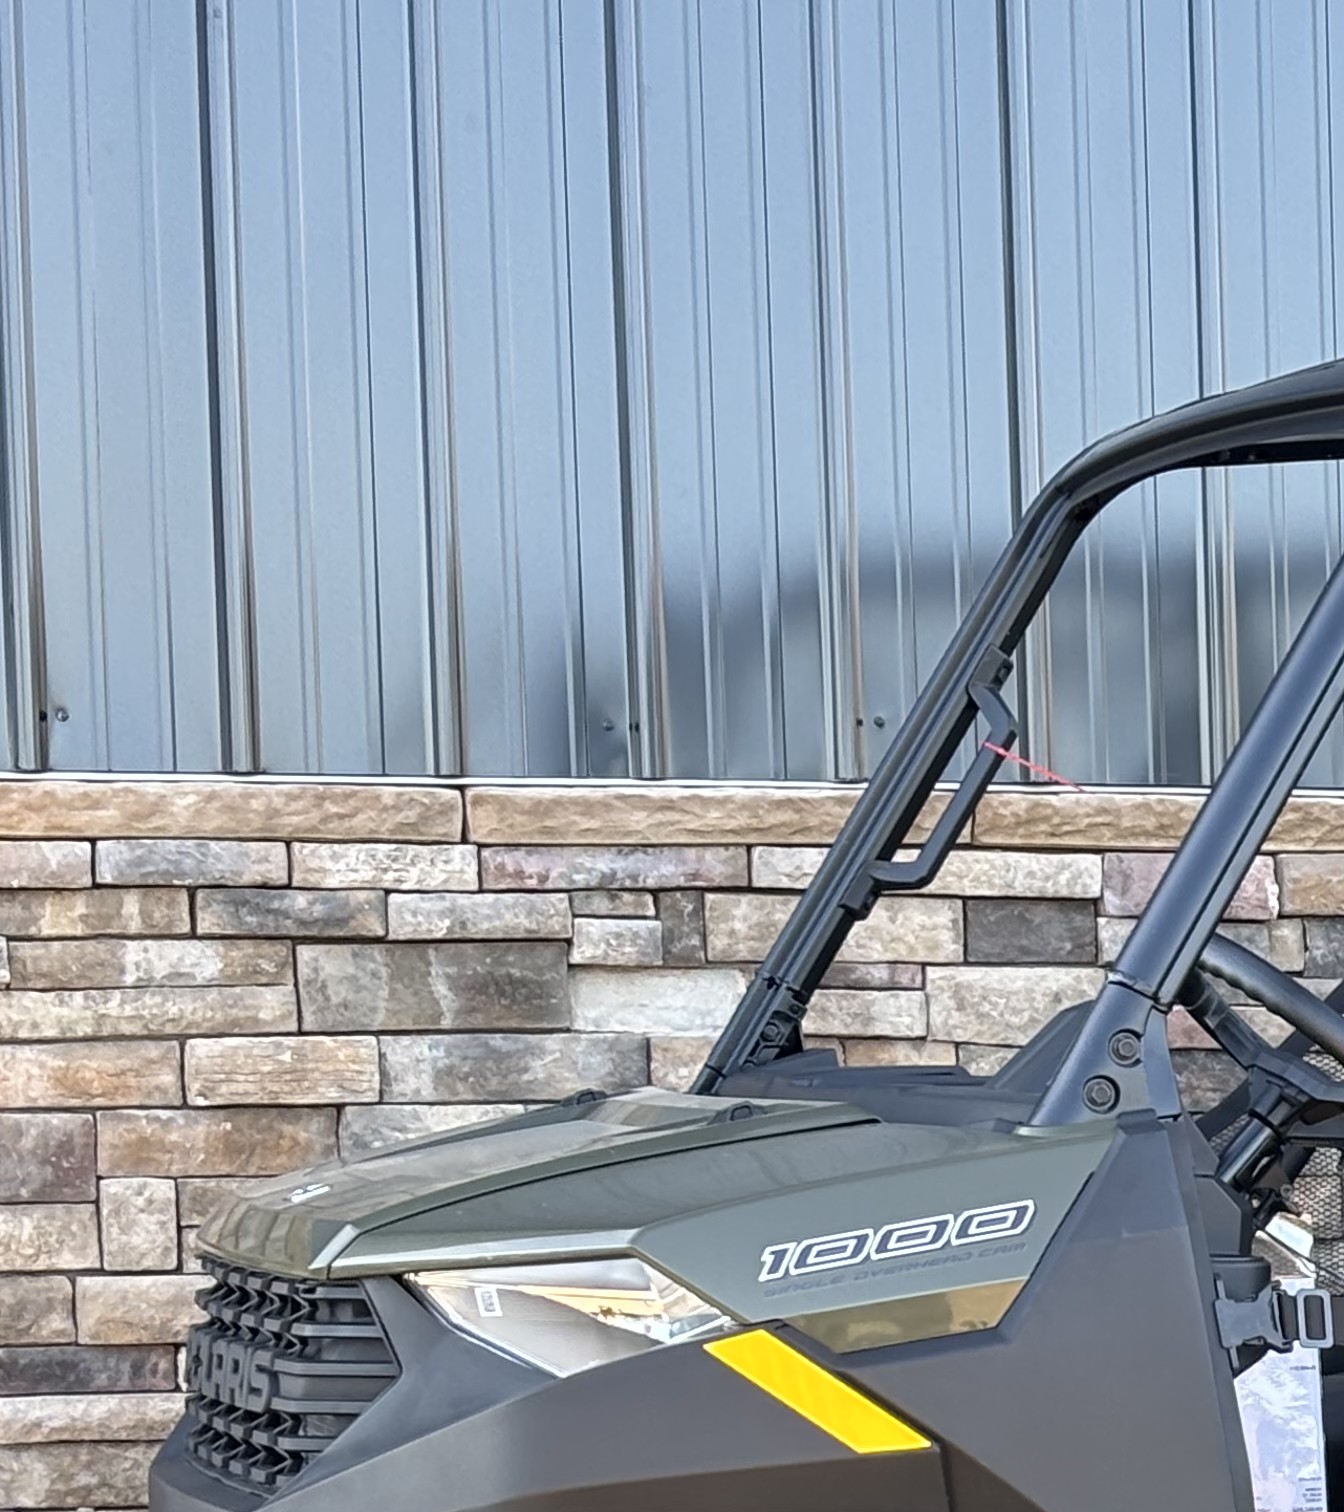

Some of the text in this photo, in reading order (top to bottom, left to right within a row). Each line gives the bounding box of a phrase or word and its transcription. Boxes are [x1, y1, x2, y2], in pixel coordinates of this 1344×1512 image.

[758, 1198, 1036, 1282] 1000
[763, 1241, 1028, 1299] SINGLE OVERHEAD CAM
